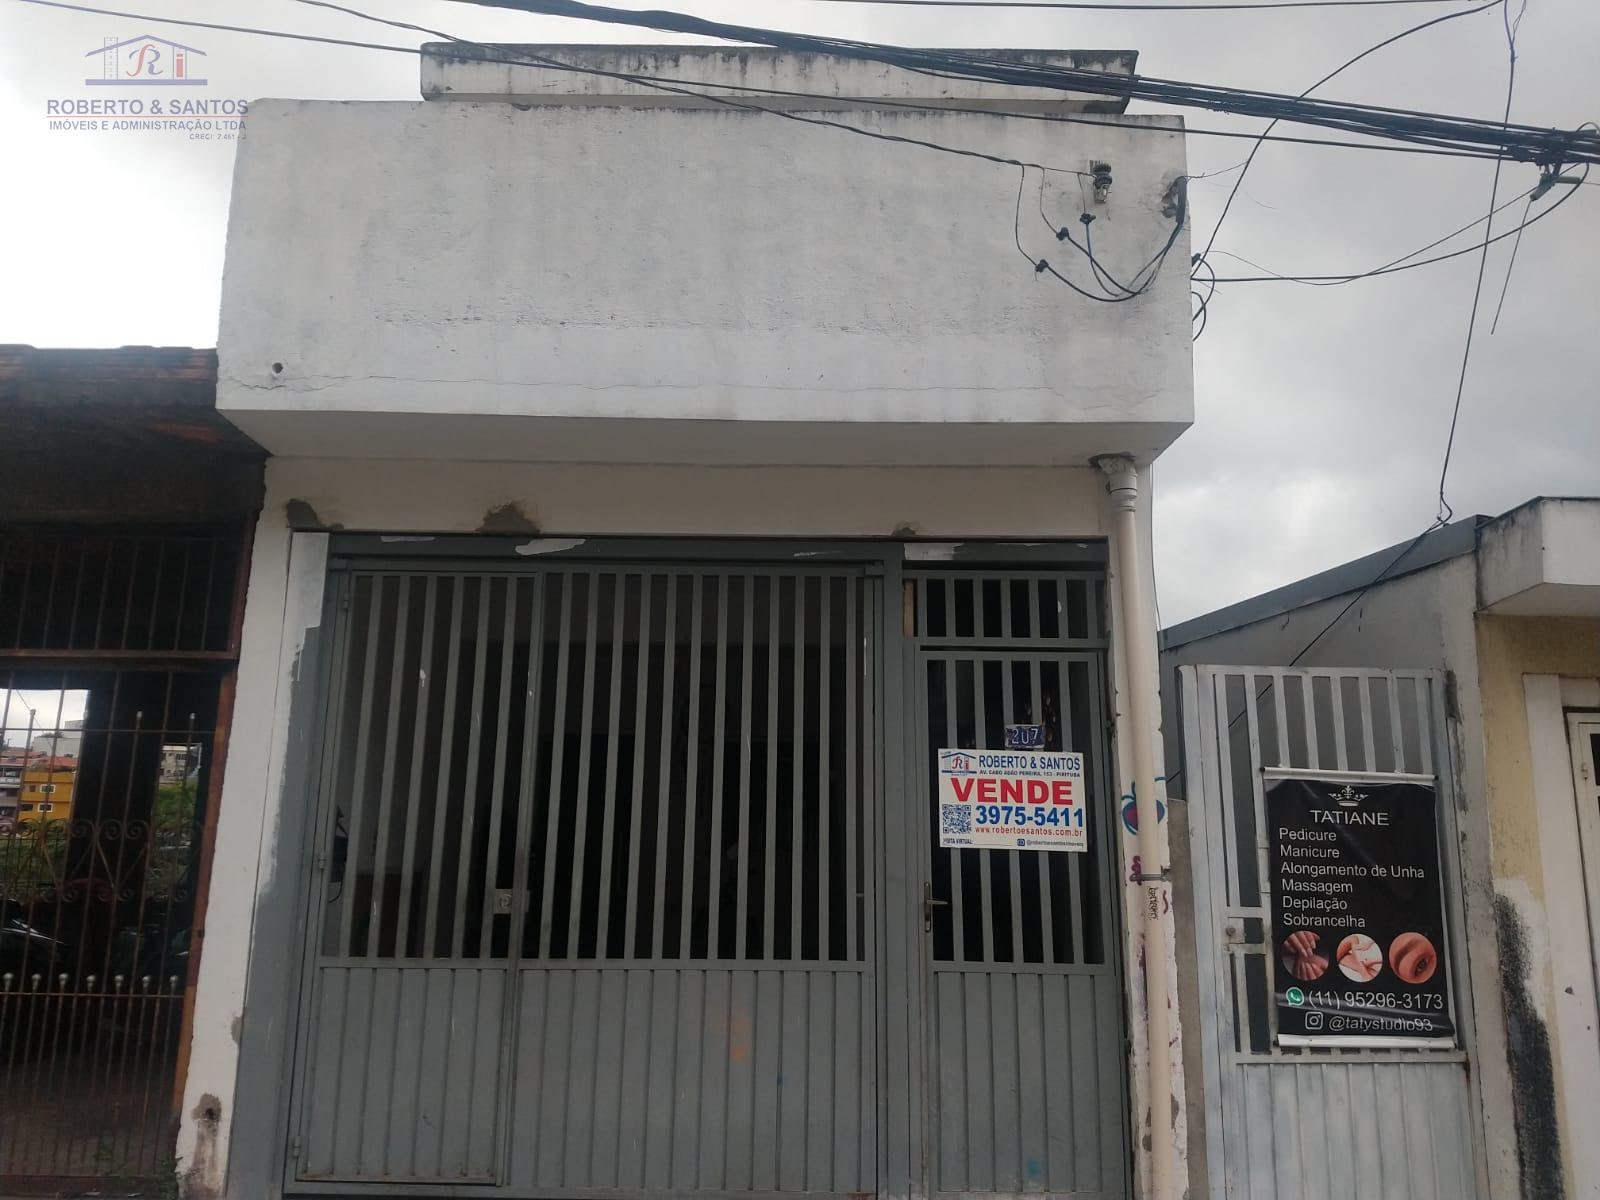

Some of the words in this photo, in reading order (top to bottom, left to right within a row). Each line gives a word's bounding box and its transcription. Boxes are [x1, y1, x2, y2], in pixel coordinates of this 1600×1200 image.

[1011, 727, 1039, 745] 207
[979, 755, 1027, 769] ROBERTO
[1030, 756, 1037, 769] &
[1039, 757, 1081, 771] SANTOS
[950, 777, 1073, 805] VENDE
[975, 805, 1083, 828] 3975-5411
[1309, 810, 1390, 826] TATIANE
[975, 826, 1083, 837] www.robertoesantos.com.br
[1279, 827, 1337, 841] Pedicure
[1280, 844, 1340, 858] Manicure
[1280, 861, 1367, 877] Alongamento
[1371, 864, 1387, 877] de
[1390, 865, 1425, 878] Unha
[1282, 878, 1353, 895] Massagem
[1282, 895, 1348, 913] Depilação
[1283, 913, 1366, 928] Sobrancelha
[1308, 989, 1341, 1010] (11)
[1344, 991, 1443, 1010] 95296-3173
[1328, 1015, 1433, 1032] @tatystudio93
